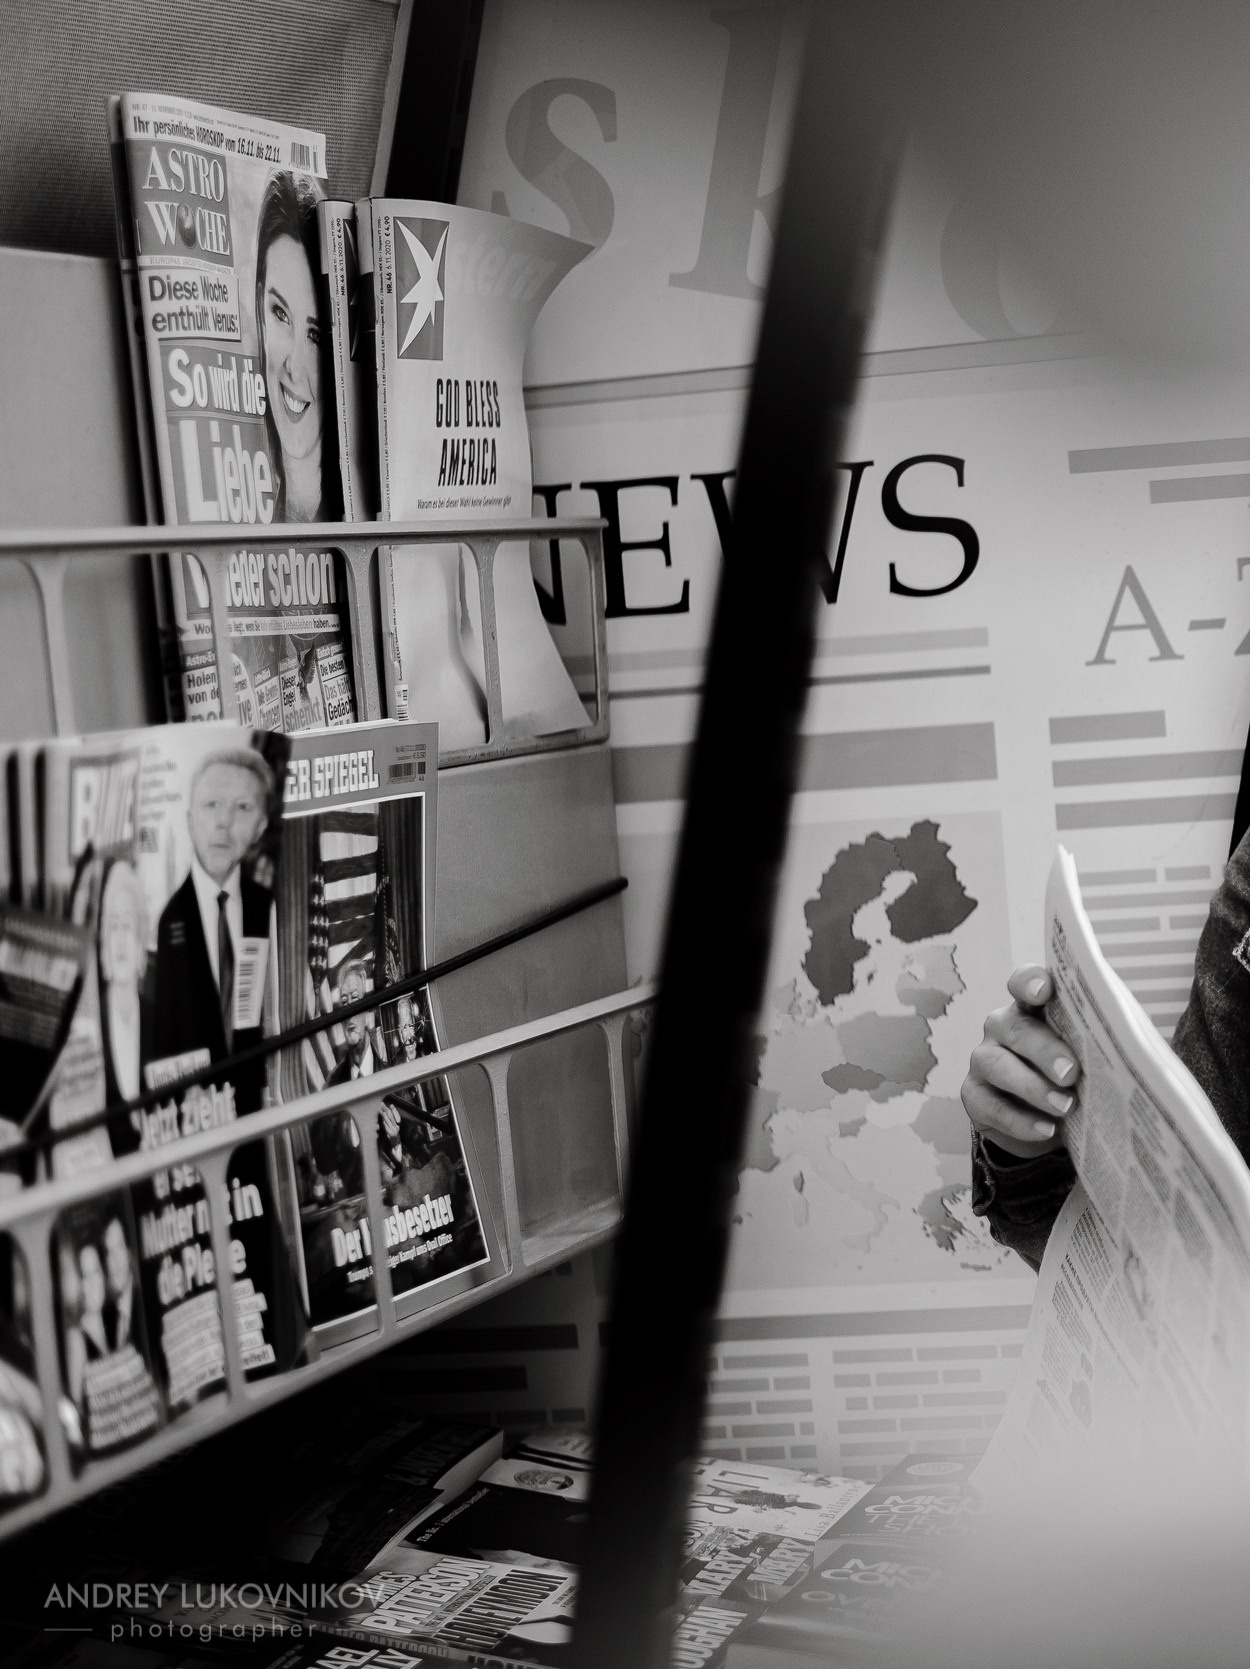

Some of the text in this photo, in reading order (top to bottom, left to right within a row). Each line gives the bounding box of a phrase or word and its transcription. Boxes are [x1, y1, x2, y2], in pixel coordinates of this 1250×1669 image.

[133, 116, 150, 134] Ihr
[152, 121, 196, 140] persönliches
[196, 126, 224, 149] HOROSKOP
[225, 140, 236, 153] vom
[237, 138, 254, 158] 16.11.
[256, 143, 264, 159] bis
[264, 147, 281, 163] 22.11.
[142, 146, 225, 203] ASTRO
[148, 275, 229, 304] Diese Woche
[152, 305, 239, 334] enthüllt Venus:
[169, 347, 267, 416] So wird die
[436, 378, 501, 428] GOD BLESS
[178, 420, 274, 525] Liebe
[438, 437, 497, 487] AMERICA
[418, 499, 433, 510] Warum
[267, 548, 336, 608] schon
[187, 672, 216, 688] Holen
[282, 674, 296, 690] Dieser
[320, 662, 329, 677] Die
[188, 691, 208, 705] von
[283, 688, 297, 708] Engel
[286, 696, 322, 733] schenkt
[284, 750, 380, 802] ER SPIEGEL
[232, 1177, 264, 1221] in
[331, 1227, 363, 1267] Der
[804, 1482, 864, 1539] Lisa Ballantyne
[682, 1549, 754, 1598] MARY
[746, 1537, 816, 1586] MARY
[350, 1570, 417, 1602] JAMES
[361, 1557, 492, 1634] PATTERSON
[432, 1568, 570, 1651] HONEYMOON
